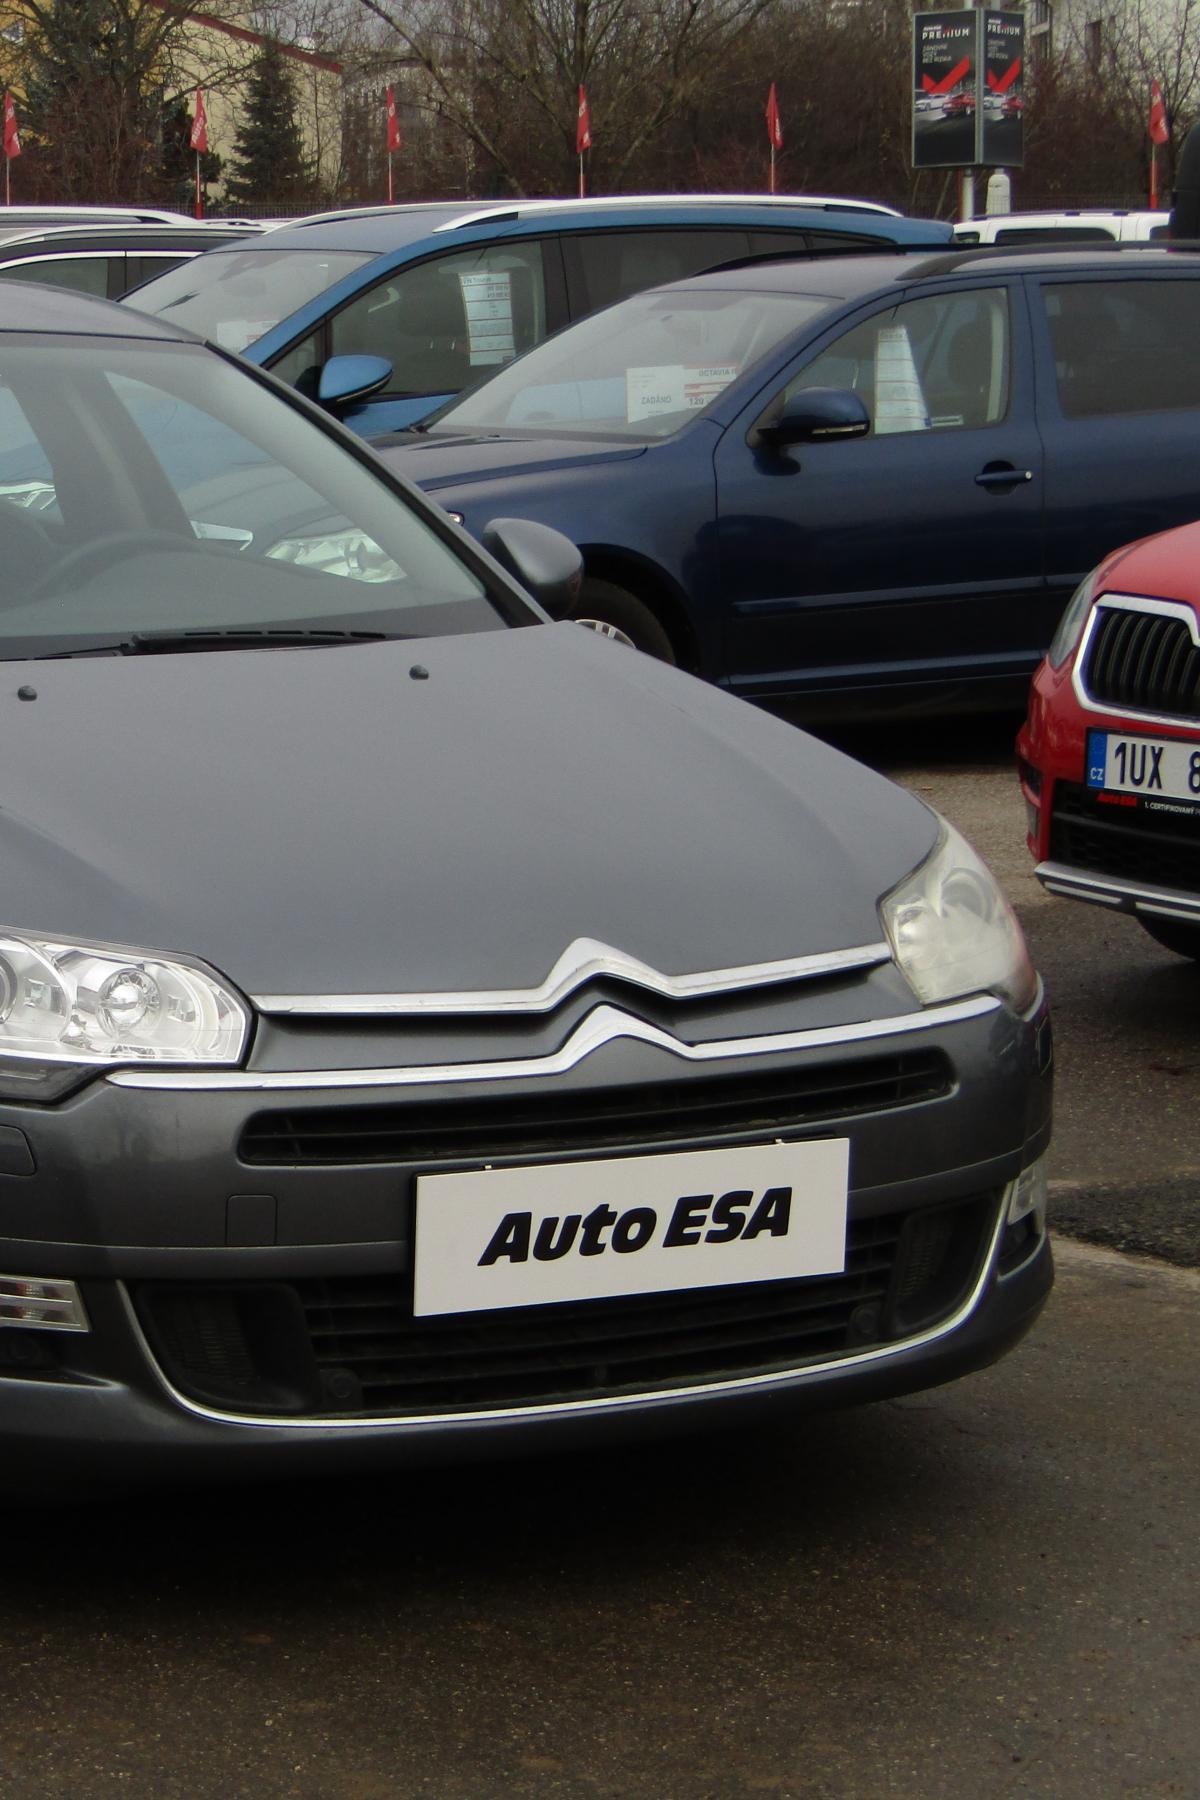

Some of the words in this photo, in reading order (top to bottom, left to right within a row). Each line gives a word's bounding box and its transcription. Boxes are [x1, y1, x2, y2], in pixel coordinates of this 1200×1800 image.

[922, 27, 970, 40] PREMIUM
[1090, 767, 1104, 780] CZ
[1114, 742, 1164, 789] 1UX
[1188, 751, 1200, 794] 8
[477, 1203, 657, 1267] Auto
[662, 1187, 793, 1248] ESA
